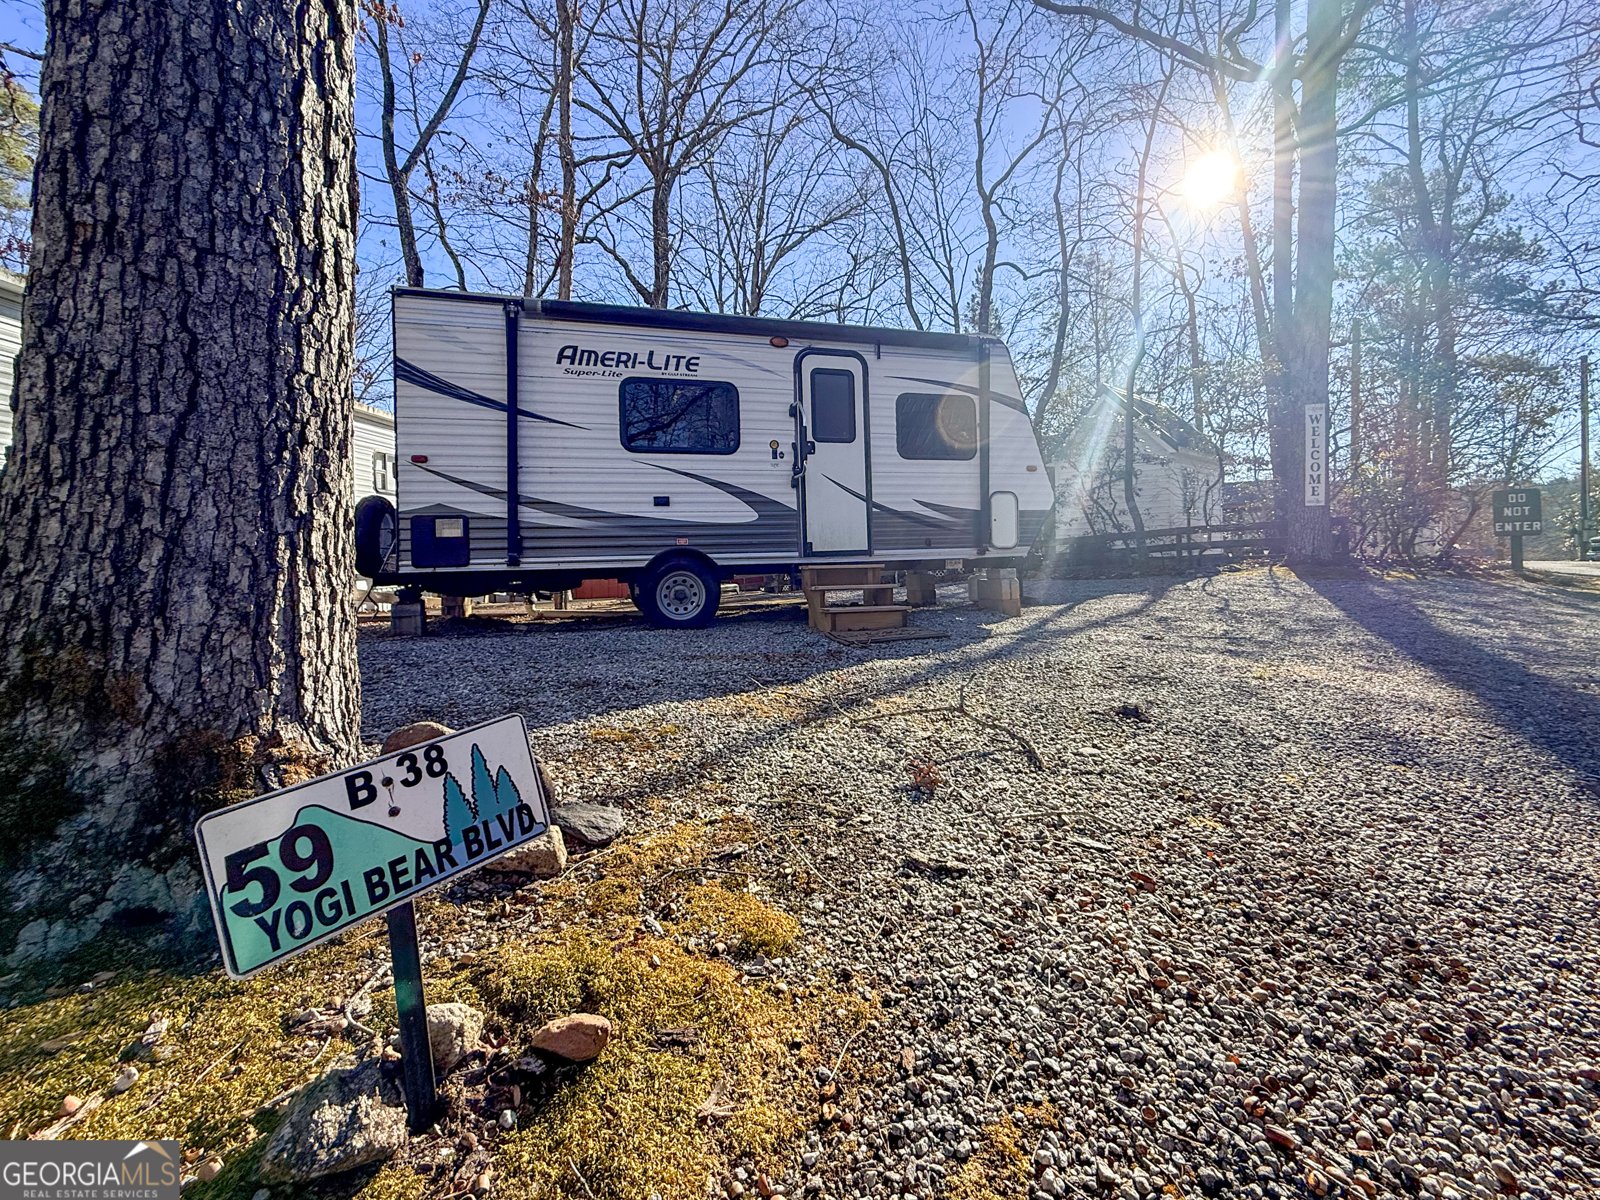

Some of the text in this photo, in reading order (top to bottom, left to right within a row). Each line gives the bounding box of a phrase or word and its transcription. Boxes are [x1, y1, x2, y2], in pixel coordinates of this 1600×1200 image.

[556, 345, 701, 373] AMERI-LITE
[563, 367, 624, 378] Super-Lite
[1308, 414, 1323, 497] WELCOME
[1508, 493, 1526, 503] DO
[1503, 506, 1531, 517] NOT
[1495, 521, 1541, 532] ENTER
[224, 824, 335, 919] 59
[254, 803, 535, 953] YOGI BEAR BLVD
